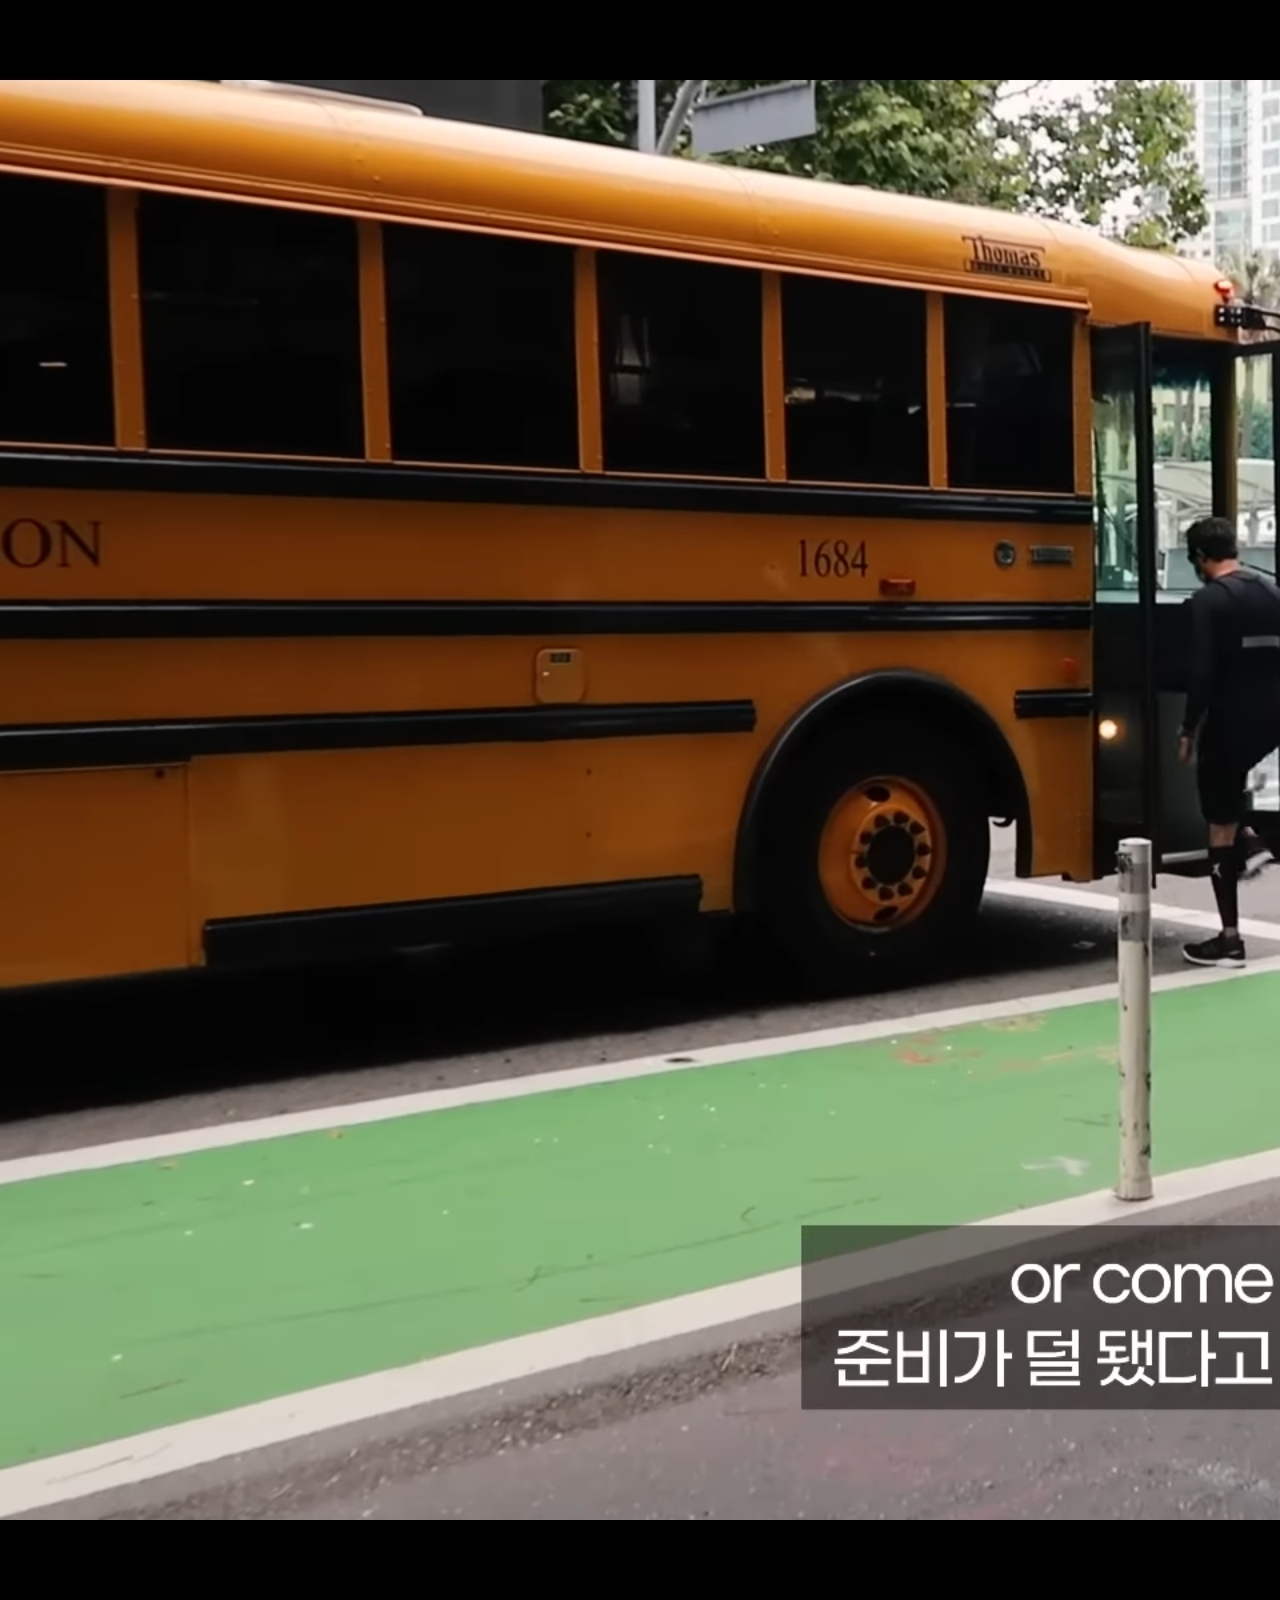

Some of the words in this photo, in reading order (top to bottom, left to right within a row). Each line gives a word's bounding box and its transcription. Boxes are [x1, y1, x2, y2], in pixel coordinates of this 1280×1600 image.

[963, 235, 1046, 268] Thomas
[1, 517, 104, 568] ON
[798, 539, 869, 578] 1684
